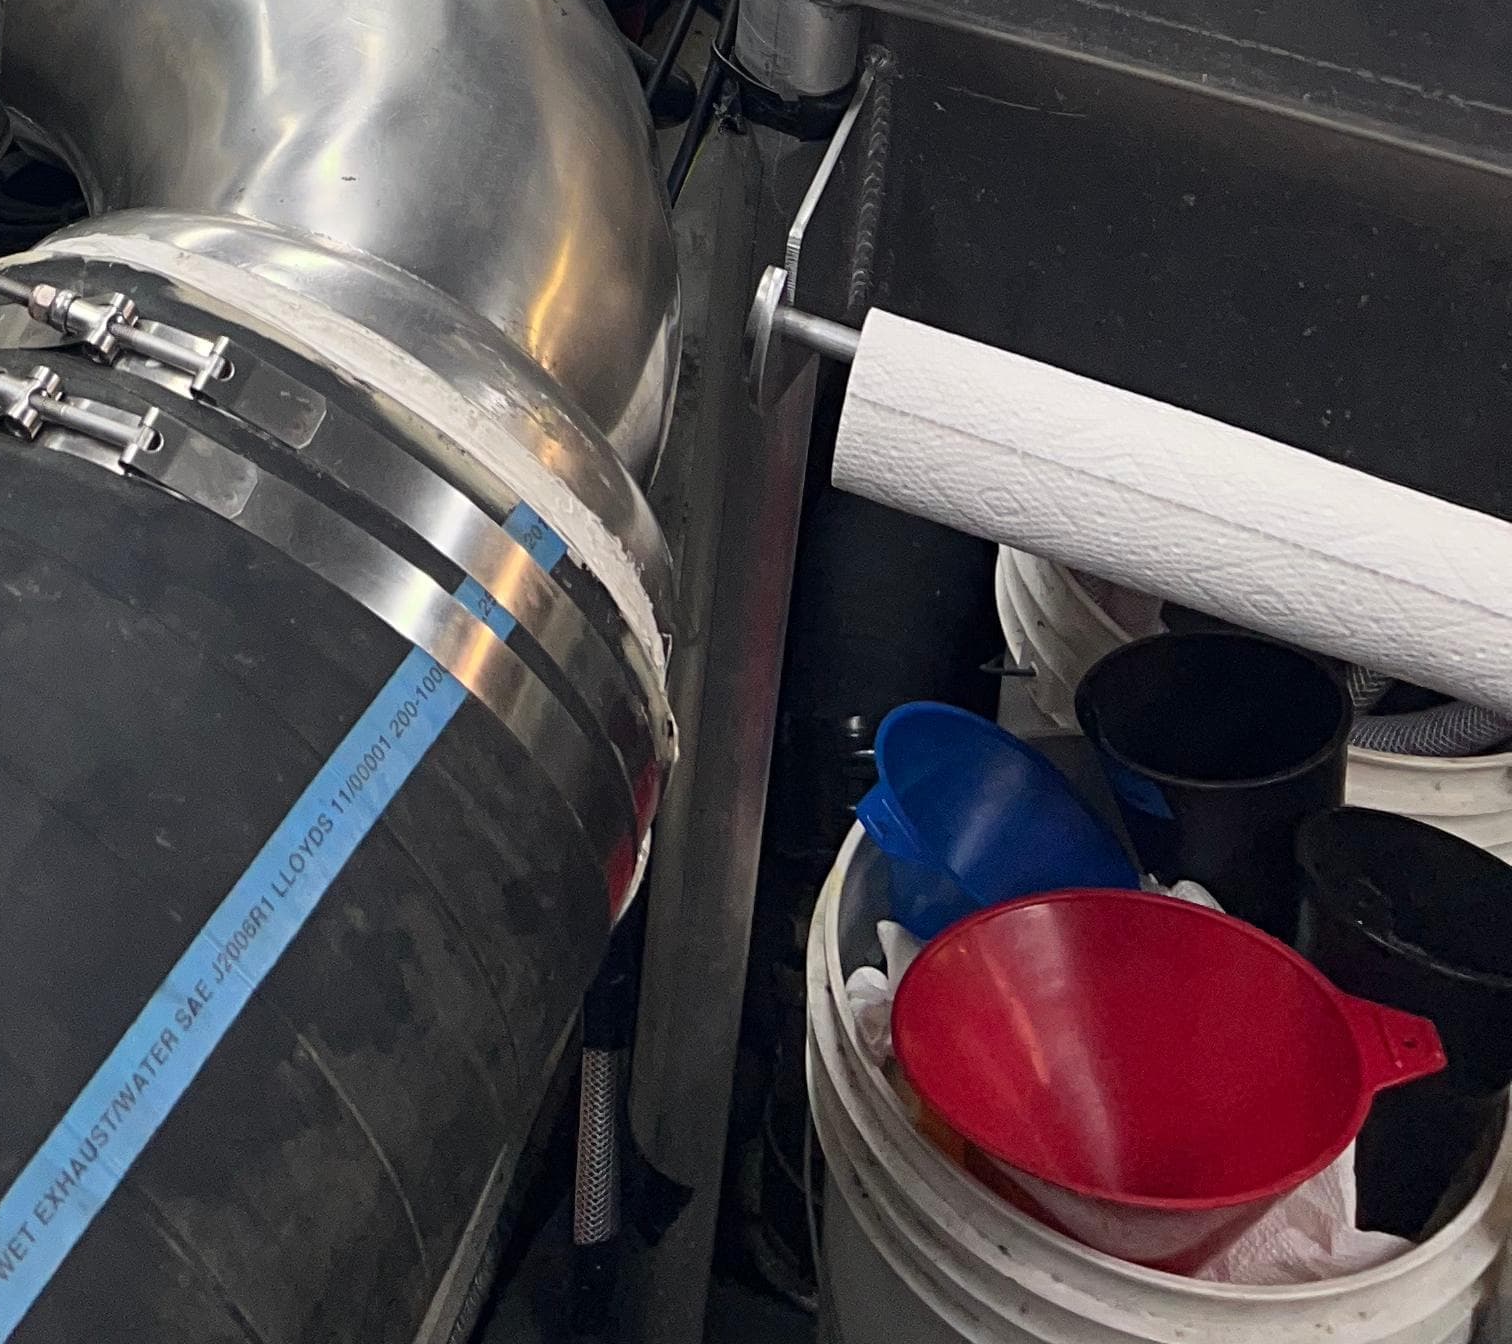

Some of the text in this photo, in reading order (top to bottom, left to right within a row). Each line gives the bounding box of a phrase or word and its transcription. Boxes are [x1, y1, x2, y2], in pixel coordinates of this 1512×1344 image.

[33, 1028, 179, 1227] EXHAUST/WATER
[174, 979, 214, 1032] SAE
[215, 895, 276, 985] J2006R1
[270, 812, 334, 899] LLOYDS
